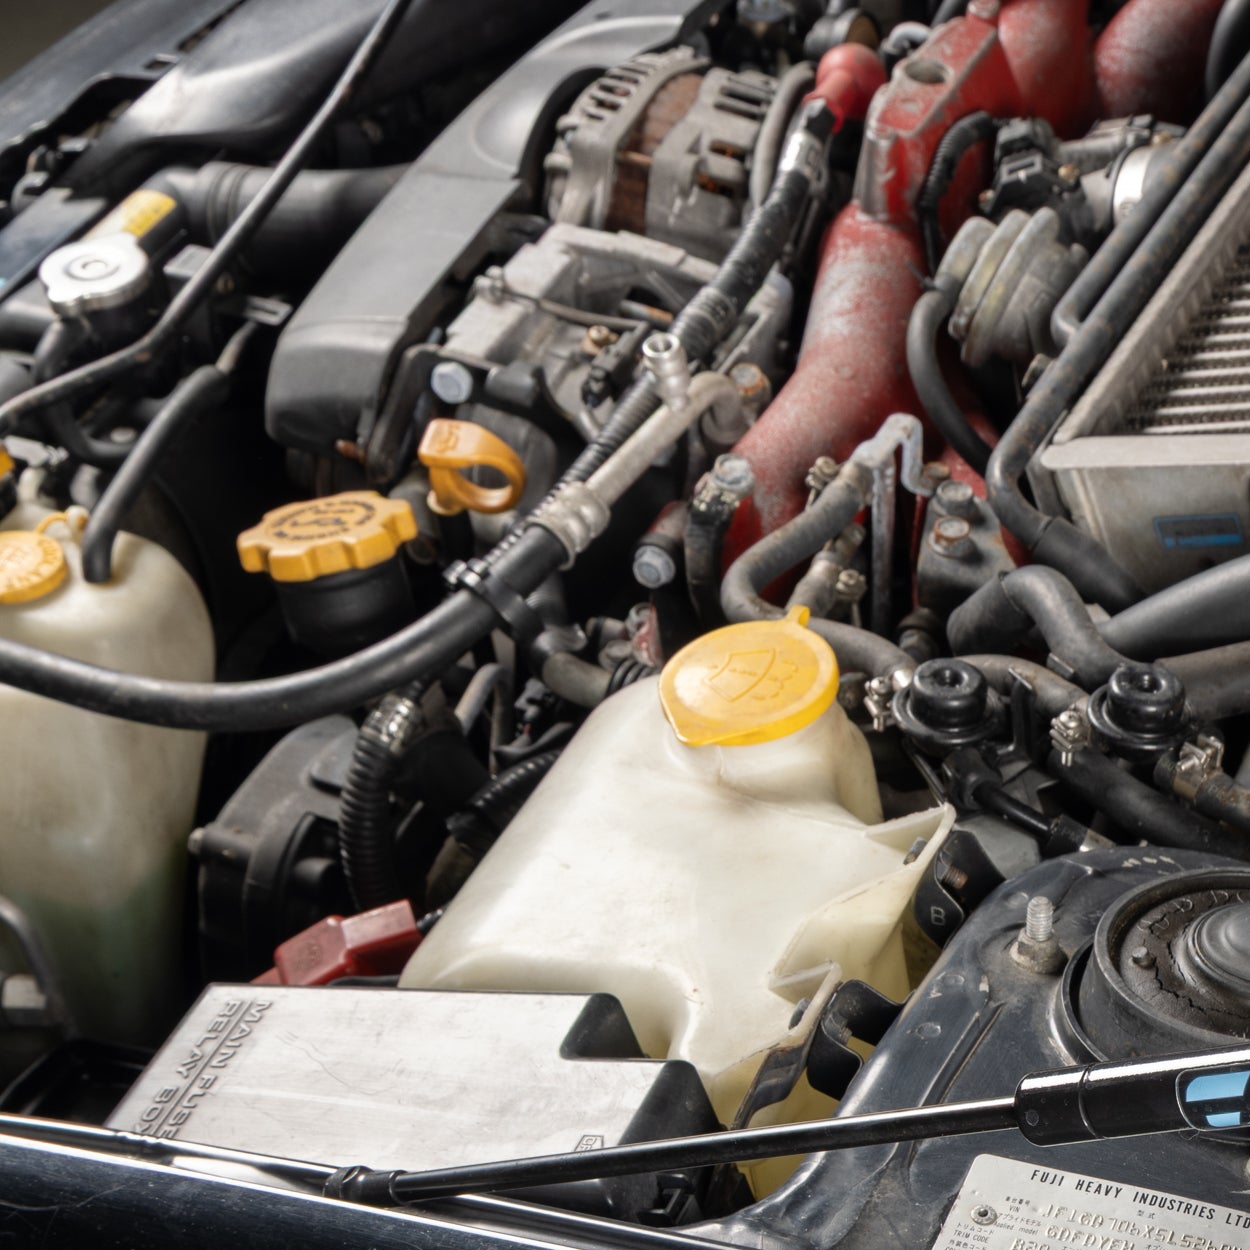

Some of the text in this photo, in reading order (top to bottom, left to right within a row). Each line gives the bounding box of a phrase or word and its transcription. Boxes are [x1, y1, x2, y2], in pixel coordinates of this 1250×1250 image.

[175, 1000, 242, 1078] RELAY
[210, 1001, 273, 1068] MAIN
[1009, 1204, 1020, 1213] VIN
[1030, 1169, 1065, 1187] FUJI
[1074, 1179, 1124, 1199] HEAVY
[1132, 1190, 1216, 1220] INDUSTRIES
[953, 1229, 990, 1244] TRIM CODE
[1019, 1226, 1038, 1236] model
